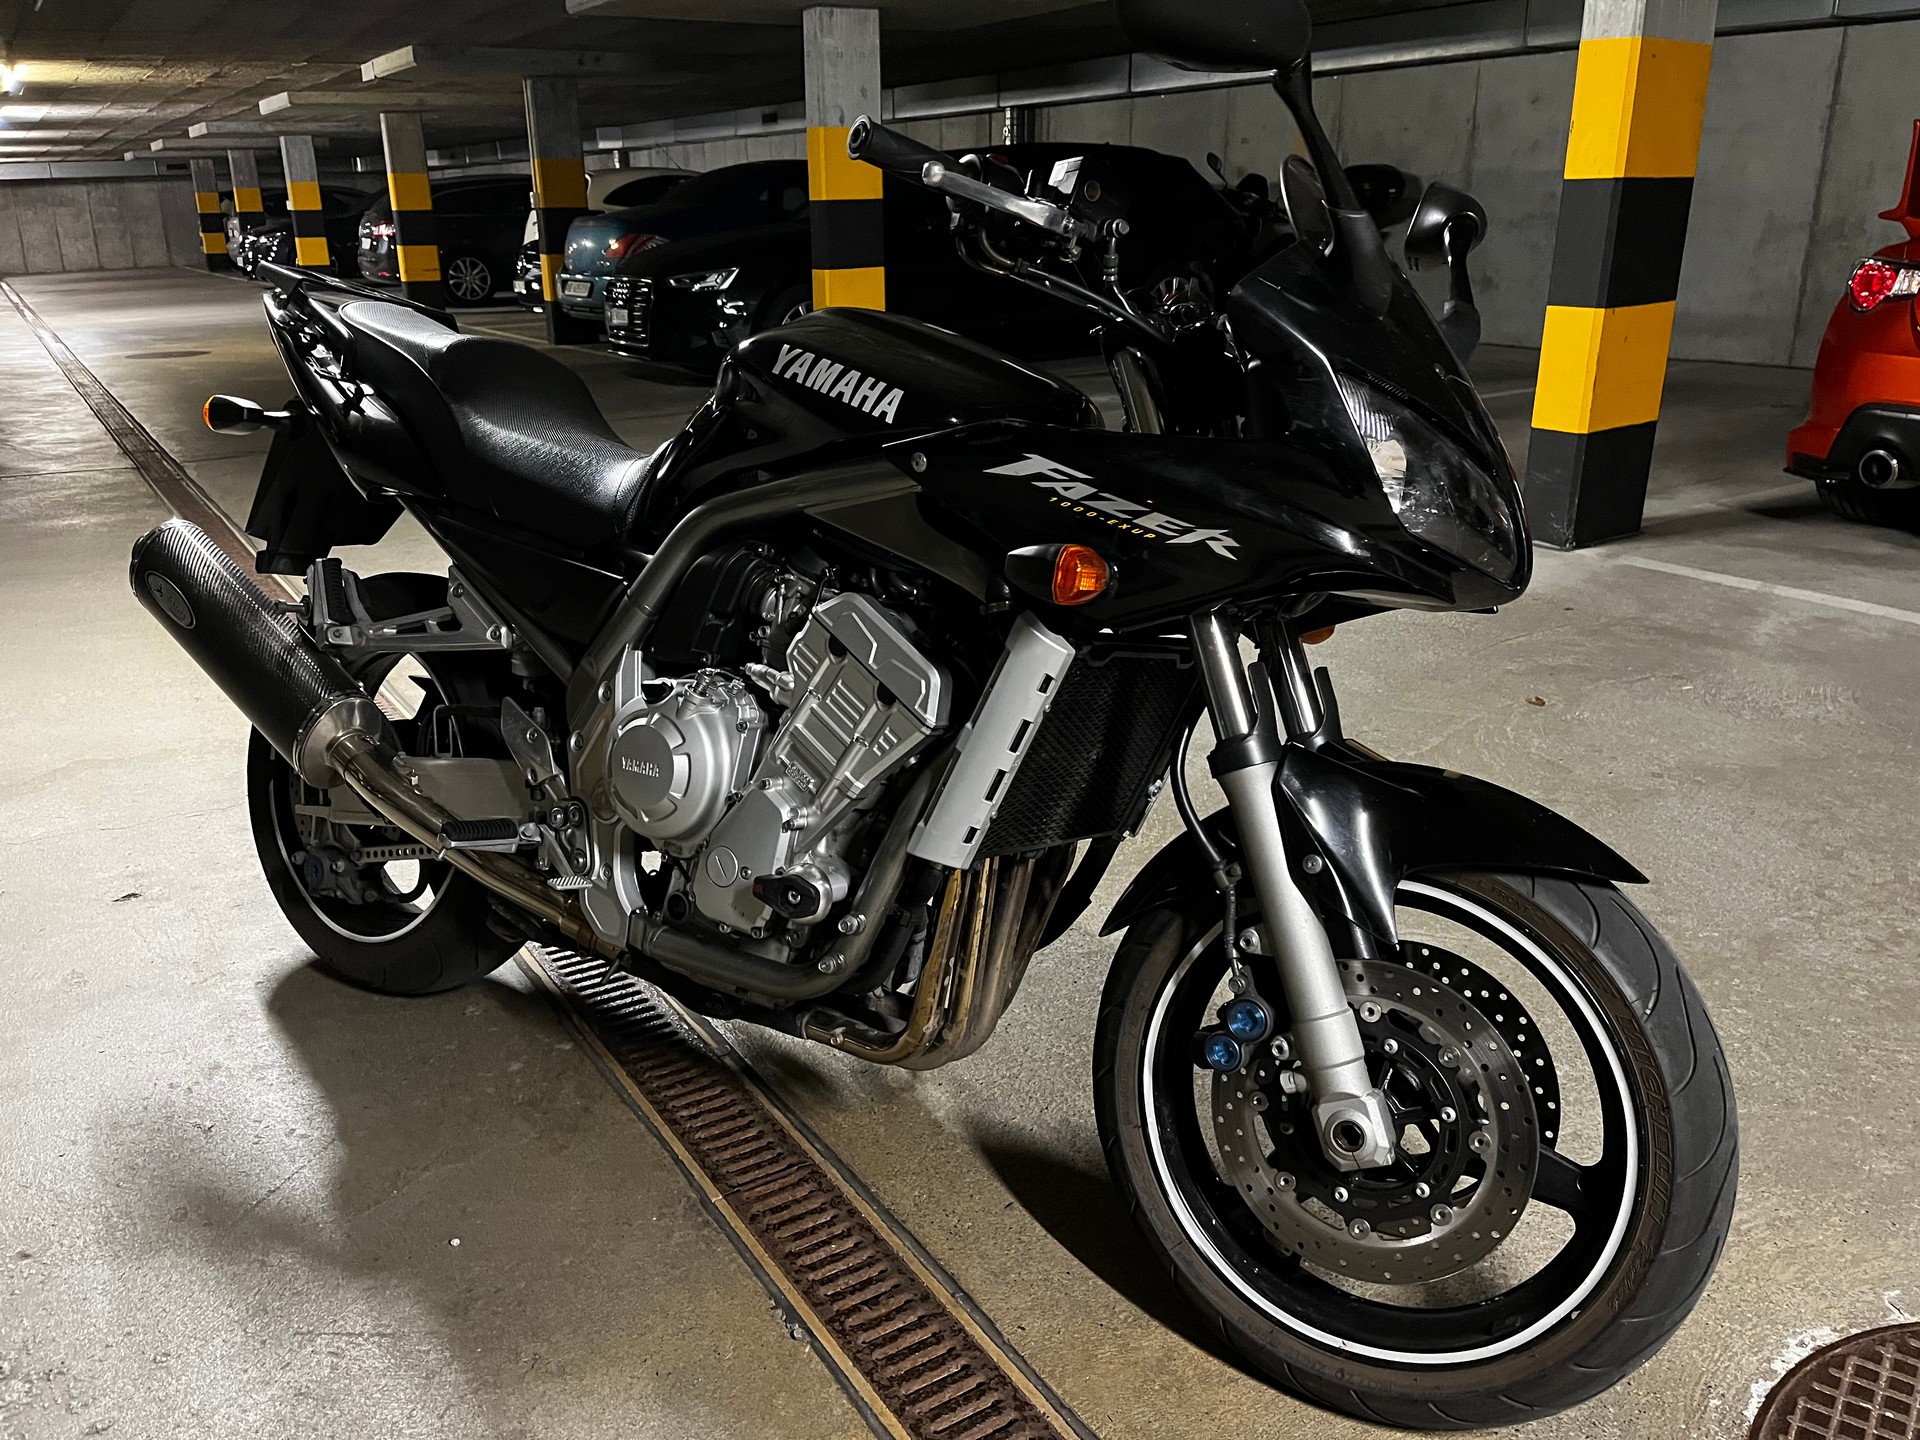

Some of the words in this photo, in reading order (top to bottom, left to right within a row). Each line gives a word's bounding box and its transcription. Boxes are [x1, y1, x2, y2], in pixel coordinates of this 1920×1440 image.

[772, 344, 904, 424] YAMAHA
[983, 453, 1240, 560] FAZER
[1050, 497, 1156, 539] 1000-EXUP
[622, 756, 659, 778] YAMAHA
[1492, 884, 1531, 914] FRONT
[1616, 1010, 1672, 1227] MICHELIN
